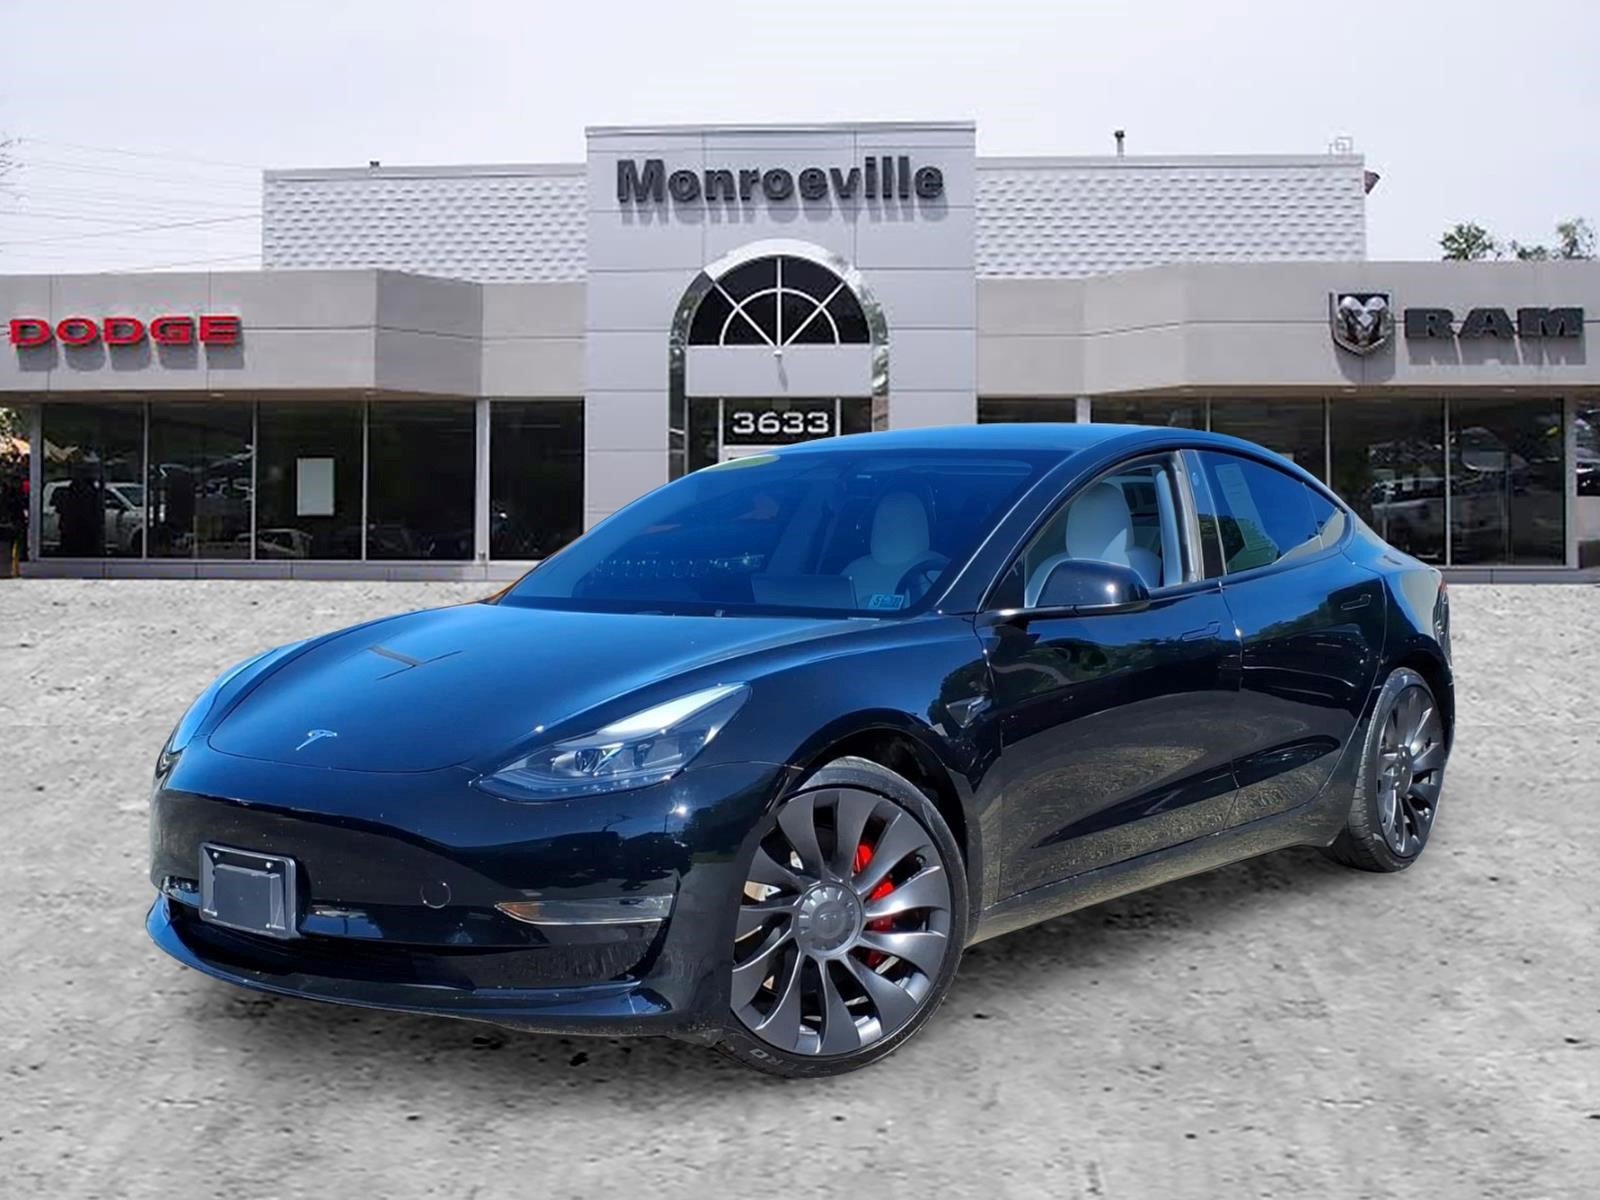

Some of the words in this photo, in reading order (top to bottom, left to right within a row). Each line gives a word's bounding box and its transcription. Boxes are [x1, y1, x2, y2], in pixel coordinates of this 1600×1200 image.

[616, 156, 944, 202] Monroeville
[9, 315, 242, 346] DODGE
[1404, 307, 1585, 339] RAM
[732, 411, 830, 434] 3633
